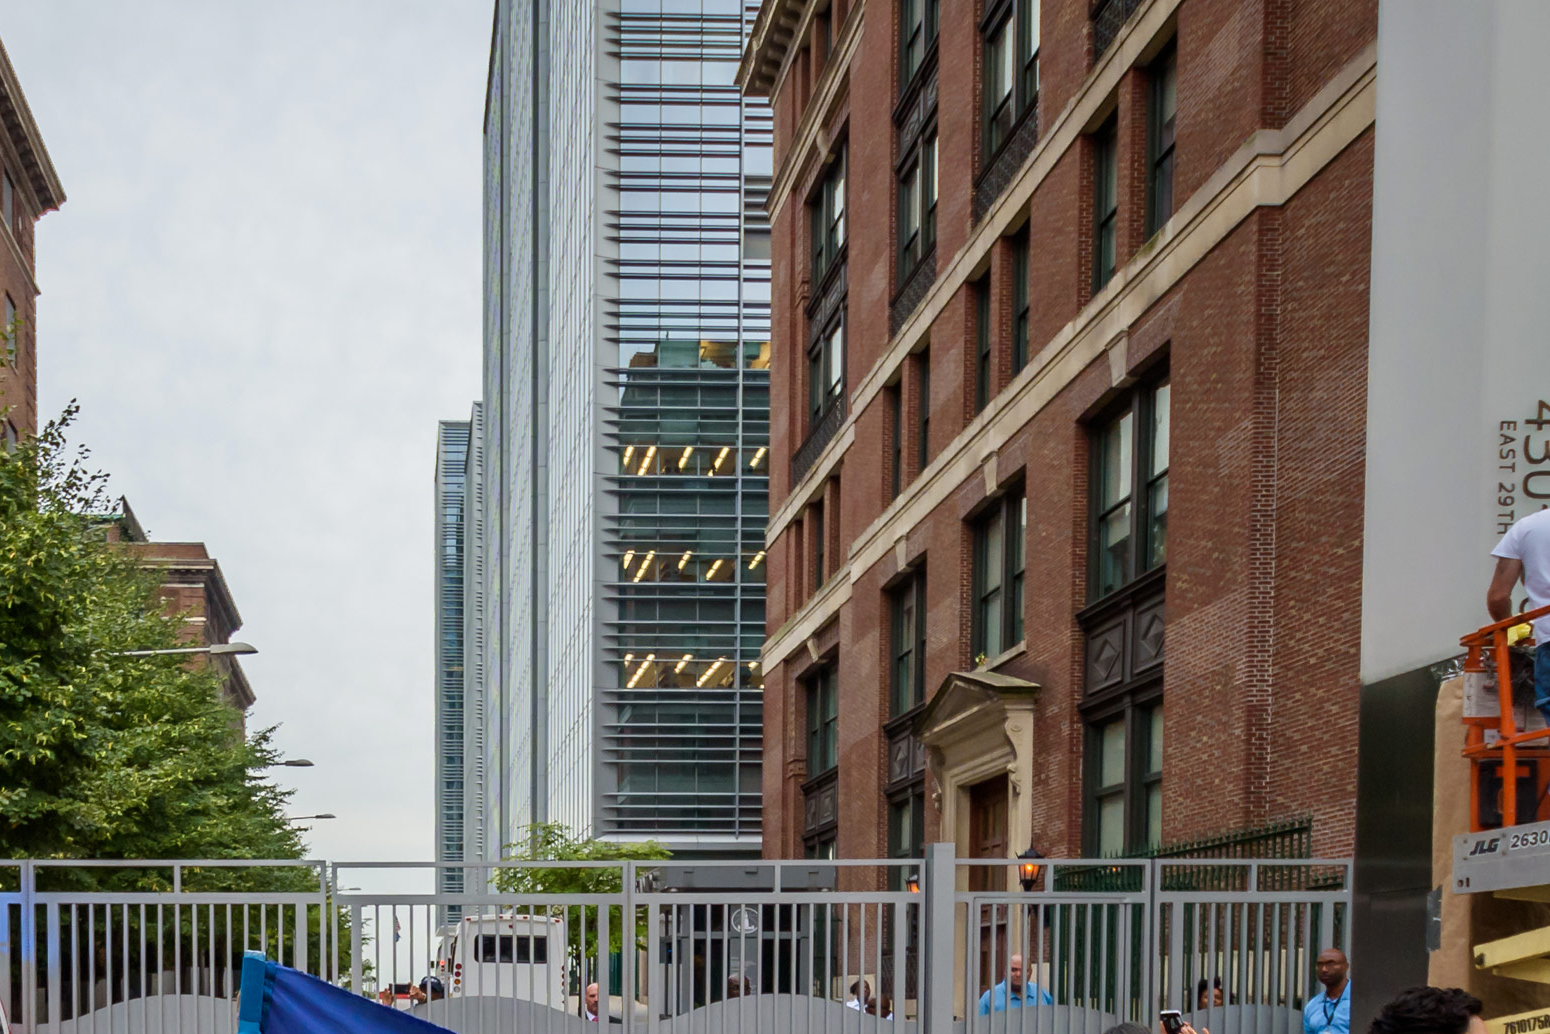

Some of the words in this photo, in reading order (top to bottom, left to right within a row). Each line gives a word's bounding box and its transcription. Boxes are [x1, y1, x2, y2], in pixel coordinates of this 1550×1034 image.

[1499, 420, 1517, 473] EAST
[1522, 399, 1550, 510] 430
[1469, 838, 1501, 856] JLG
[1510, 829, 1550, 848] 2630
